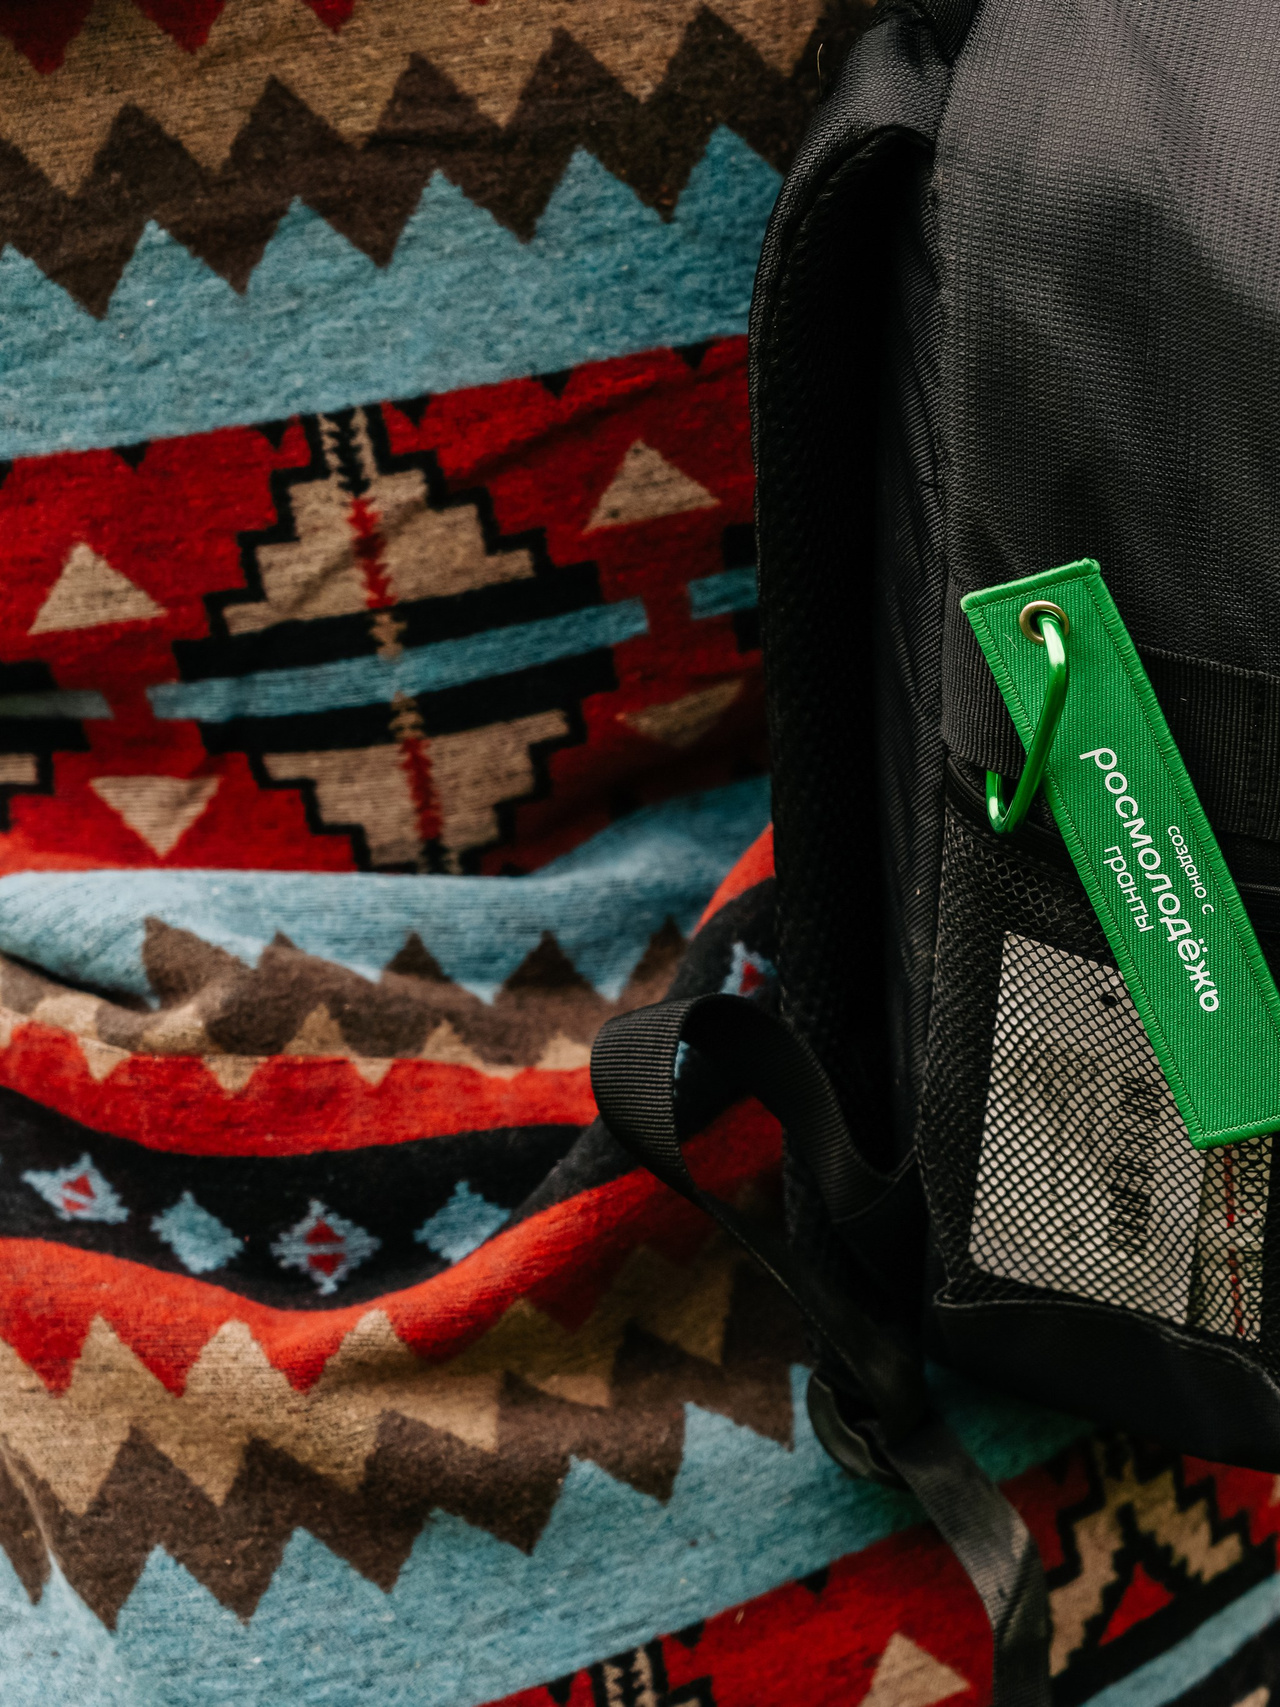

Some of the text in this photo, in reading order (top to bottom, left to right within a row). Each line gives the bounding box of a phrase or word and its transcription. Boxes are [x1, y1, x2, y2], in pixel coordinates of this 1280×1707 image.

[1079, 747, 1220, 1012] росмолодёжь
[1103, 845, 1155, 933] гранты
[1167, 825, 1215, 915] создано с
